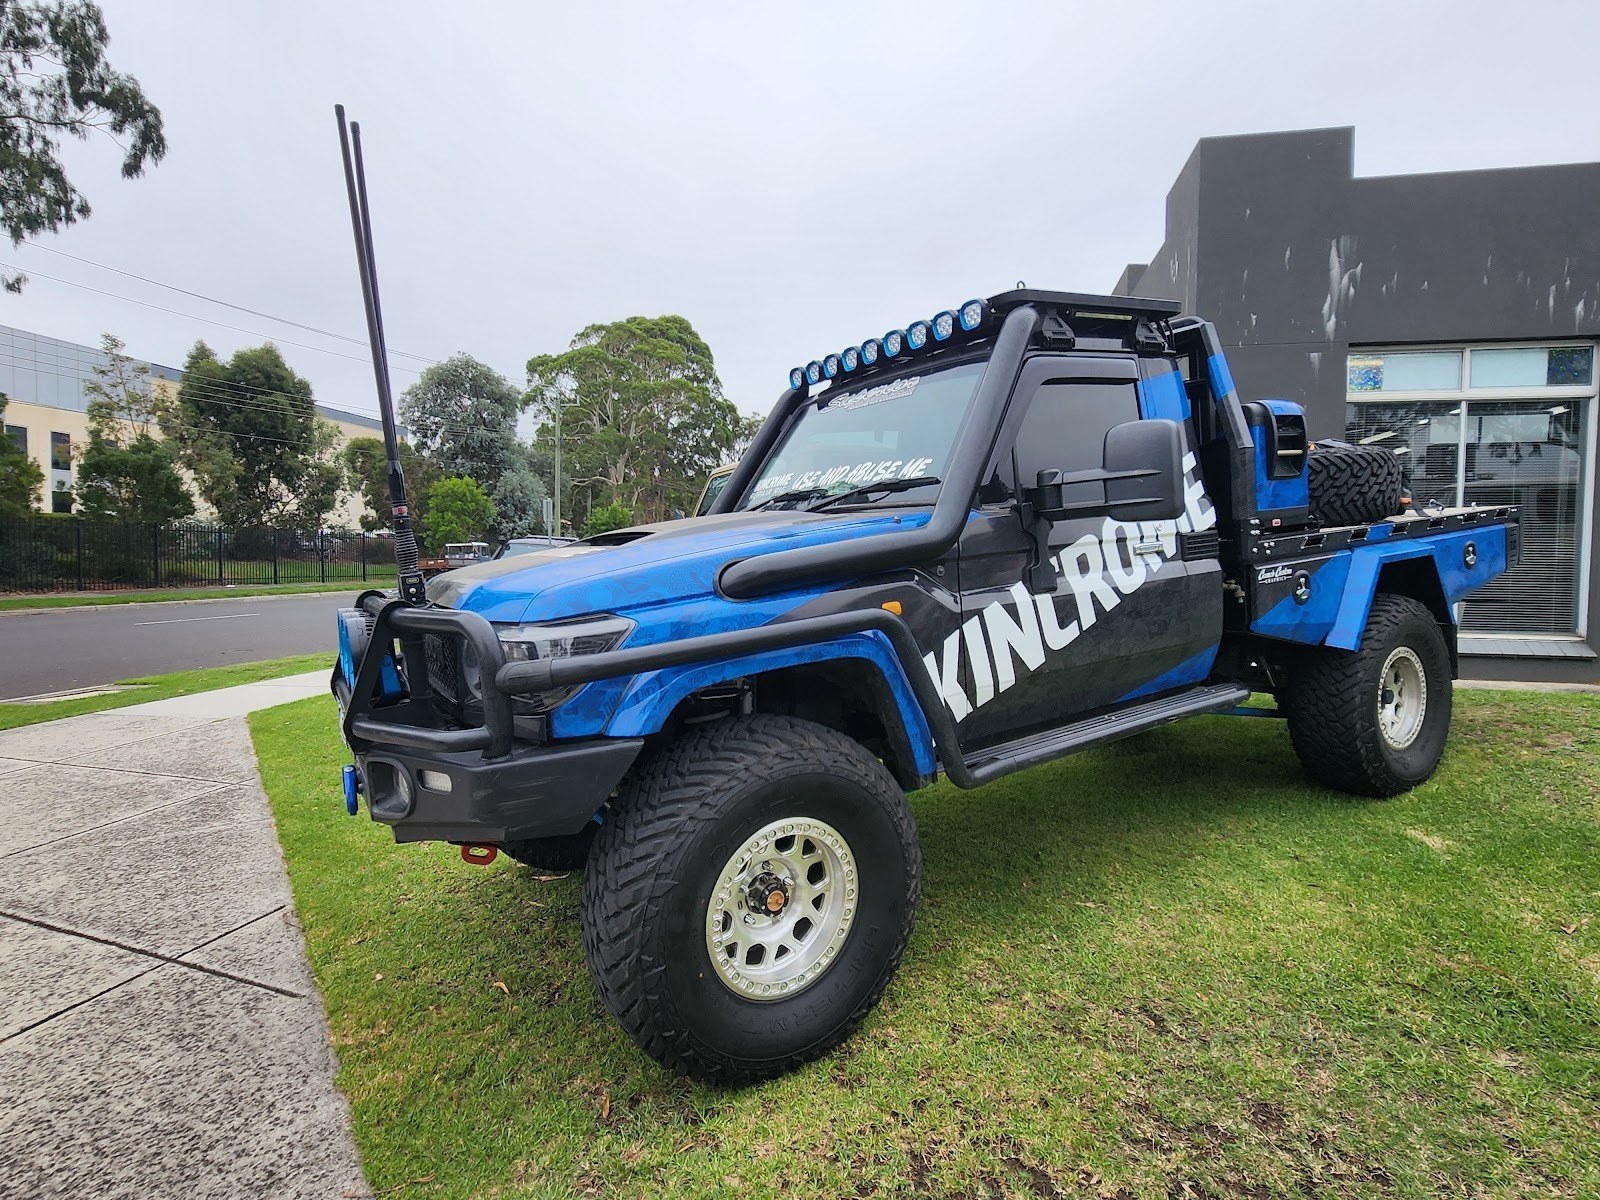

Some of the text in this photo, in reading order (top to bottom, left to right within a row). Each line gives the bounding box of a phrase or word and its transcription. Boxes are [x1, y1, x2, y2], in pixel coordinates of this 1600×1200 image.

[792, 457, 933, 490] USE AND ABUSE ME
